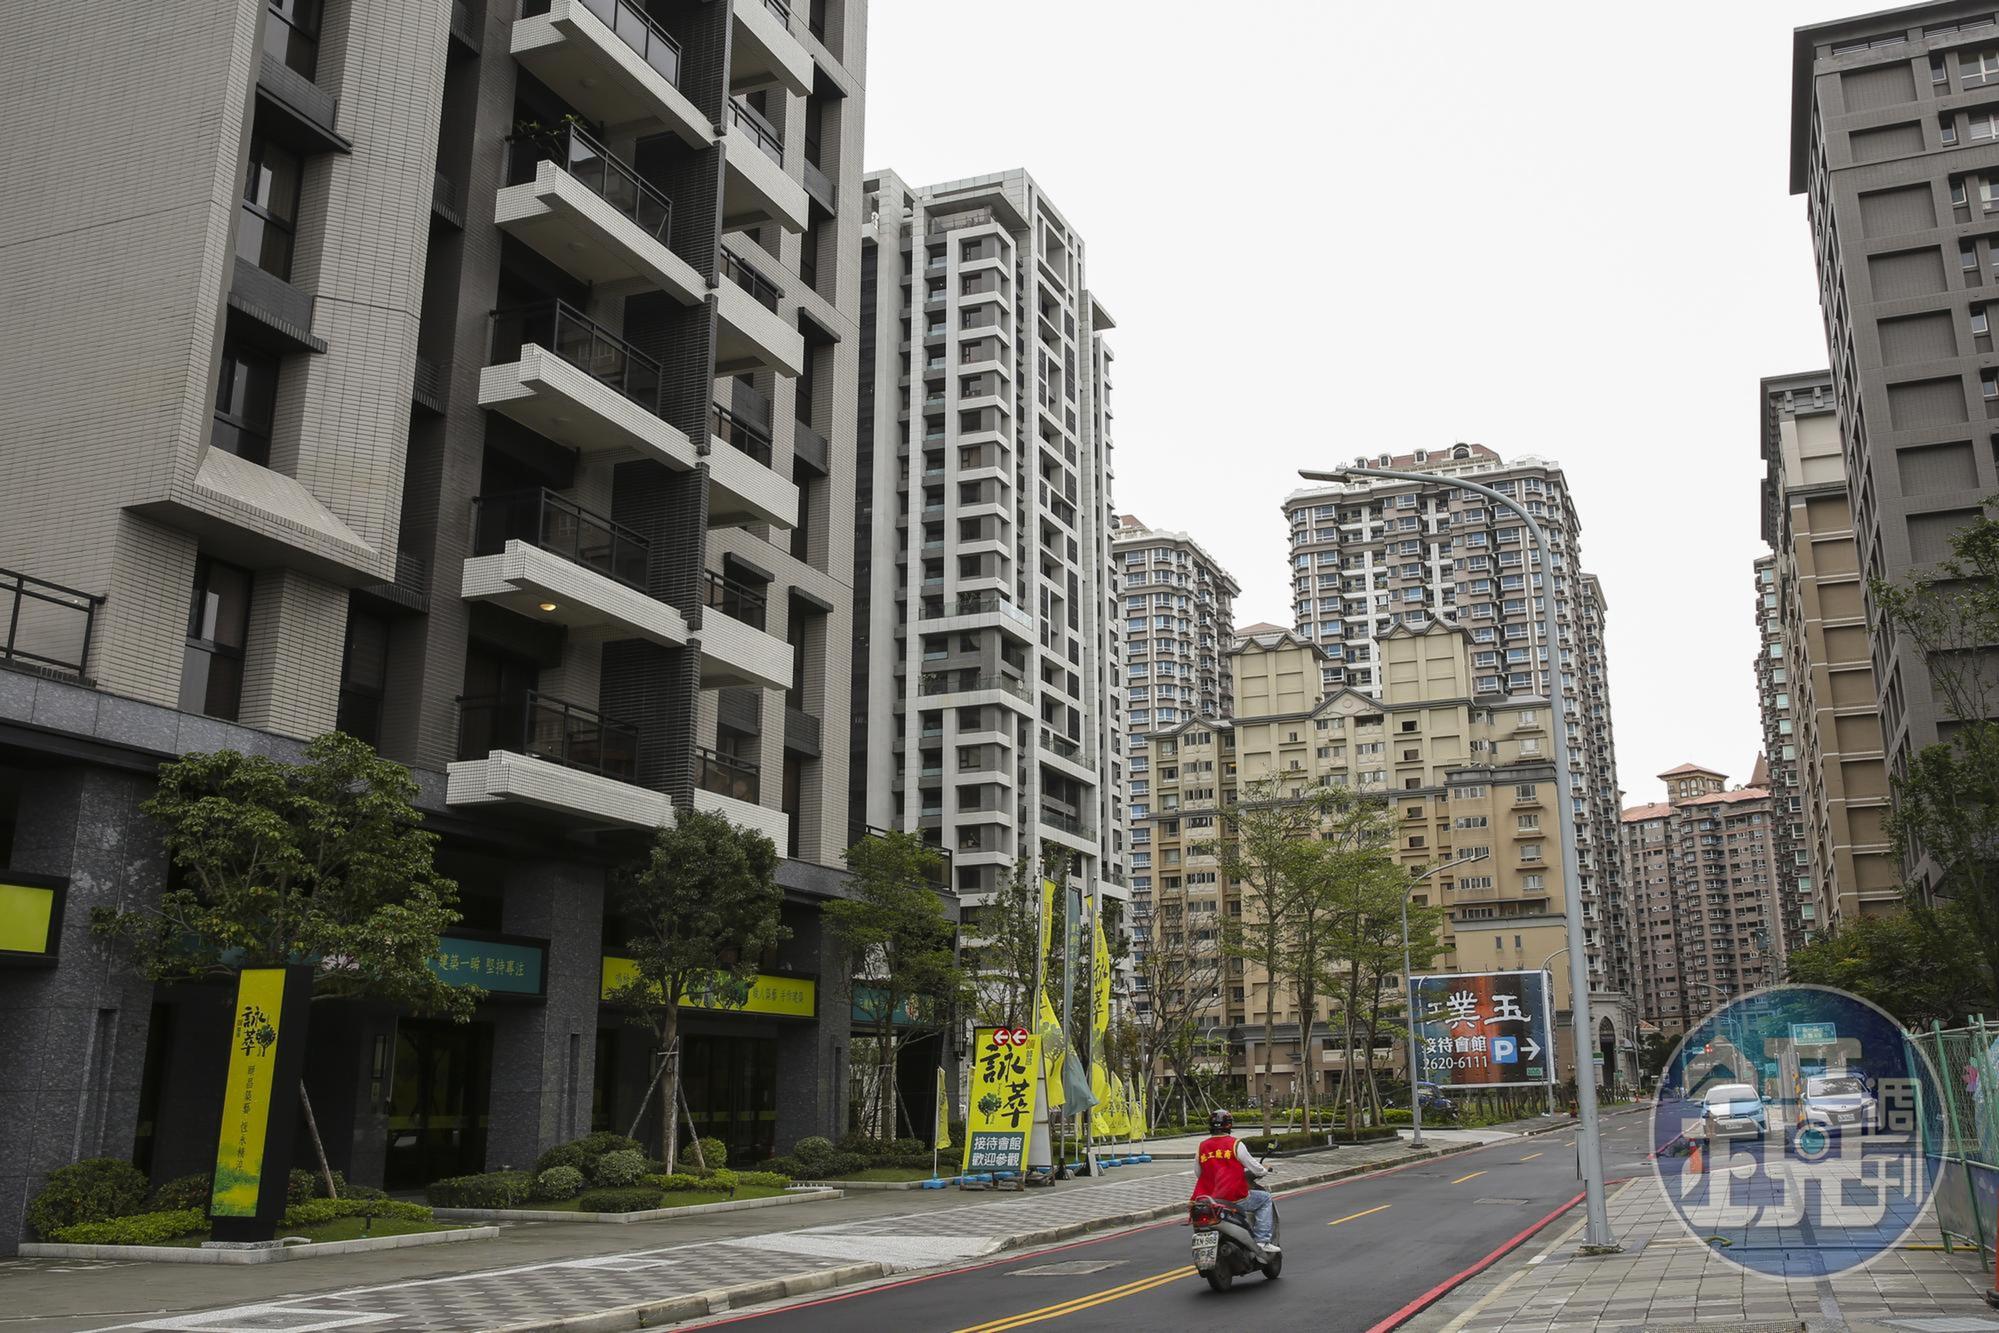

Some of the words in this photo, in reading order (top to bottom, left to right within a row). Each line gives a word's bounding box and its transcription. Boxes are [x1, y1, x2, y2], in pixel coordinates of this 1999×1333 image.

[1422, 1035, 1487, 1055] 接待會館
[1422, 1056, 1488, 1070] 2620-6111
[974, 1136, 1022, 1151] 接待會館
[972, 1152, 1020, 1167] 歡迎參觀
